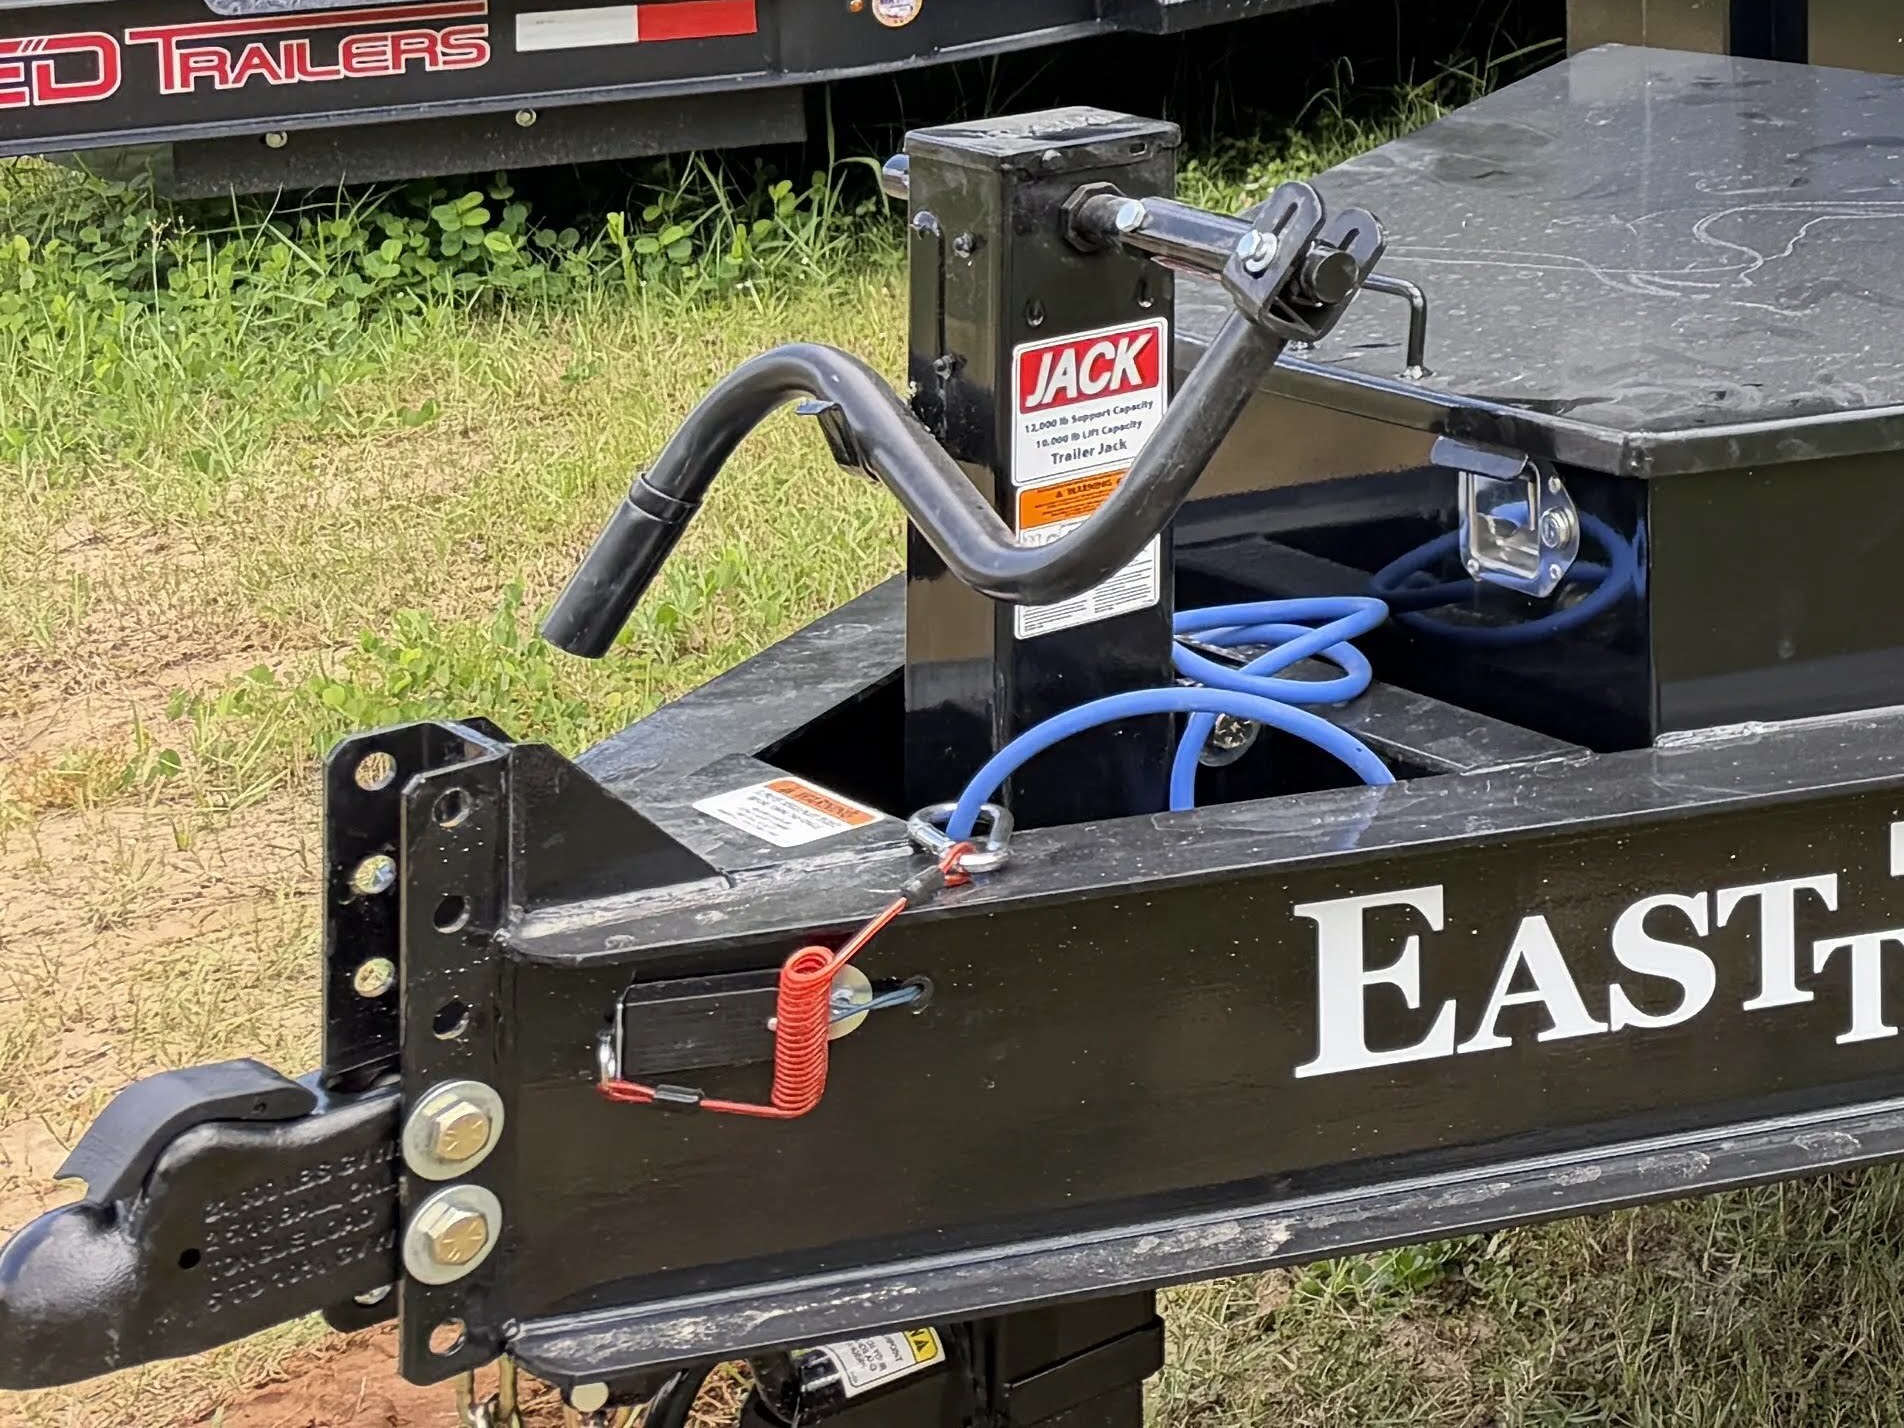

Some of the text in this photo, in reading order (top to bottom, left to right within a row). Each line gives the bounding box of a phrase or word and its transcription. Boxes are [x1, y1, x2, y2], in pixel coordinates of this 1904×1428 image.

[124, 0, 489, 95] TRAILERS
[1025, 332, 1153, 406] JACK
[1071, 408, 1111, 424] Support
[1113, 400, 1153, 415] Capacity
[1101, 420, 1142, 435] Capacity
[1051, 438, 1127, 464] Trailer Jack
[1292, 872, 1838, 1079] EAST
